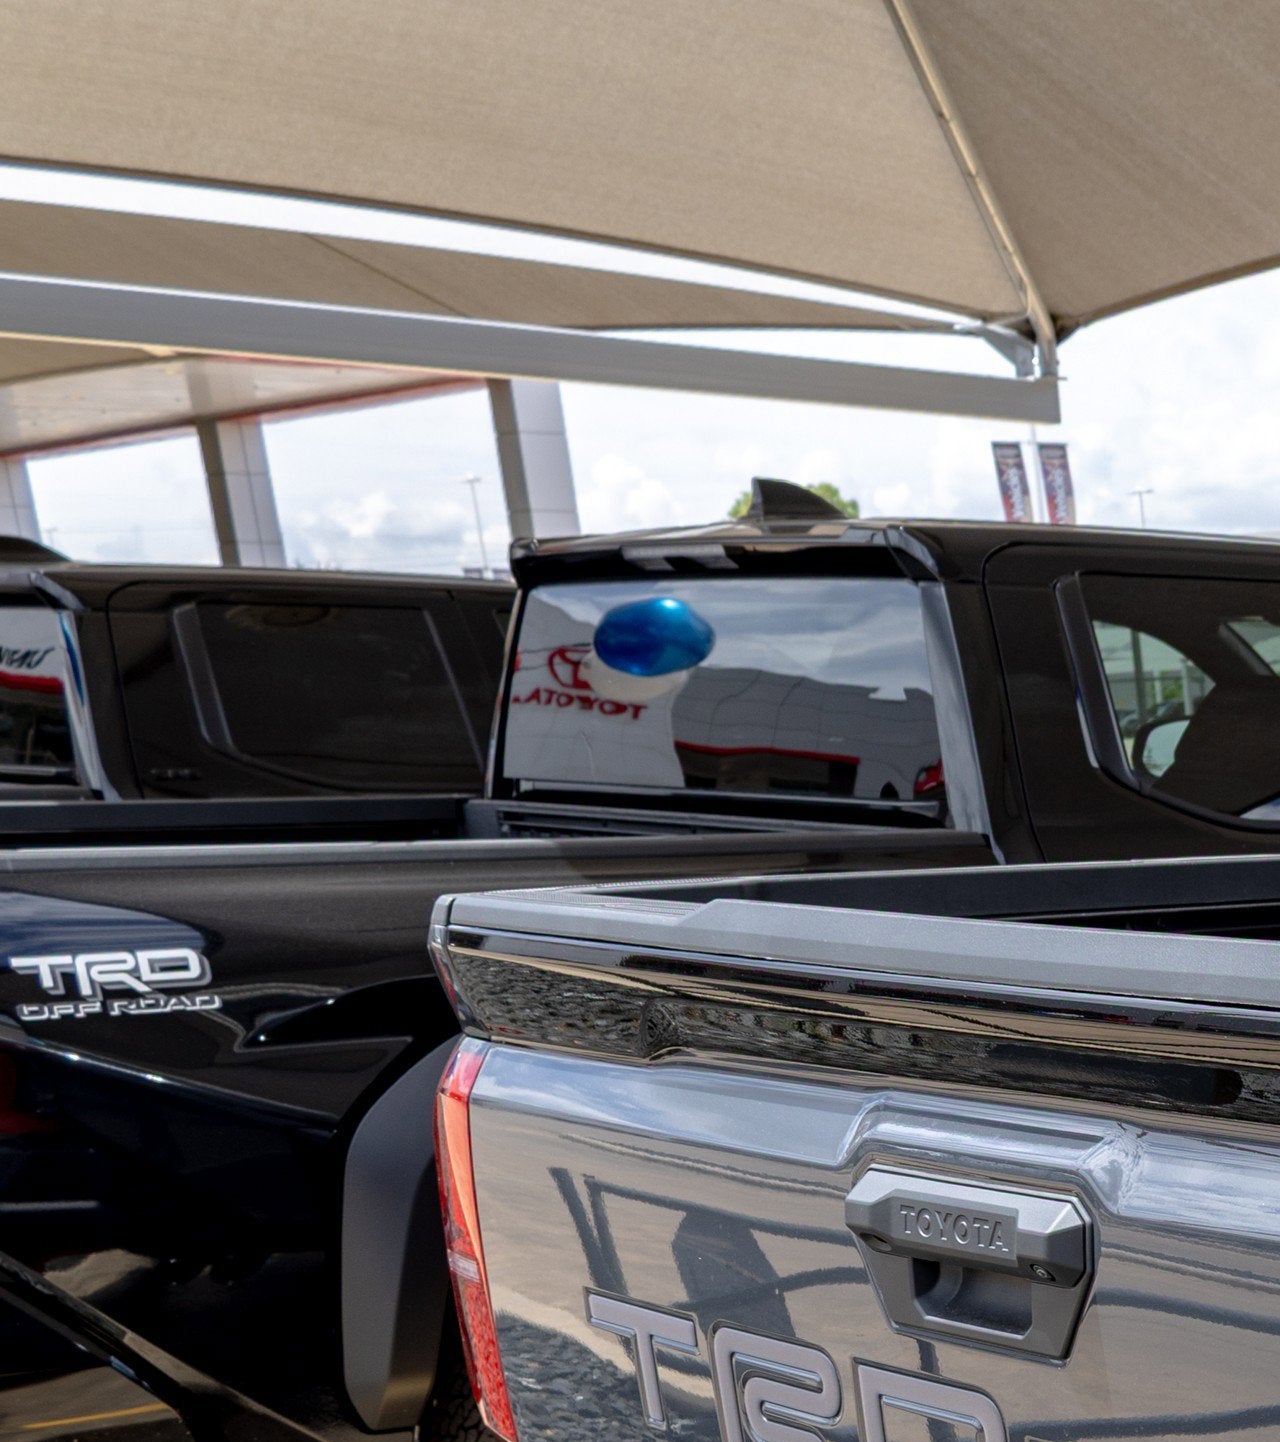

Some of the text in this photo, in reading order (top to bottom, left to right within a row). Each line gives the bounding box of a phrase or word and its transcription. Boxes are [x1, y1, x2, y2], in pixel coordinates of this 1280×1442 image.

[9, 947, 212, 1001] TRD
[18, 992, 223, 1021] OFF ROAD
[899, 1203, 1009, 1253] TOYOTA
